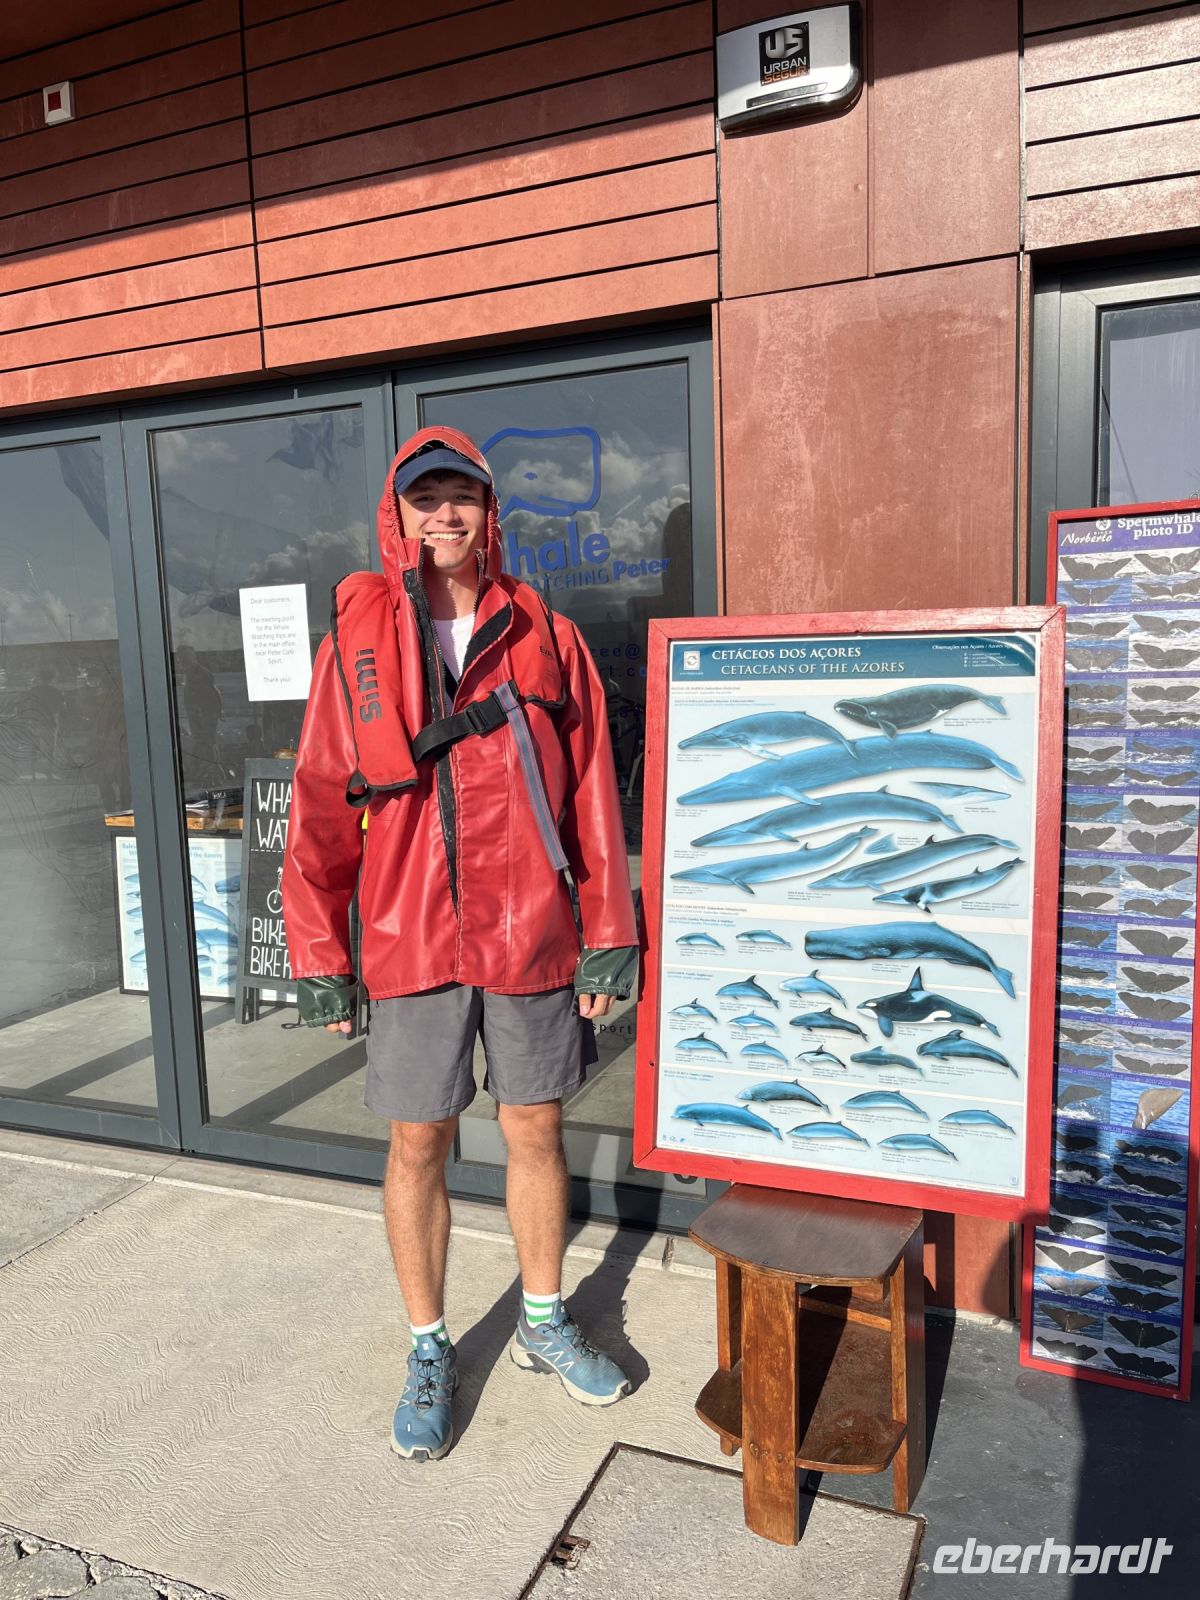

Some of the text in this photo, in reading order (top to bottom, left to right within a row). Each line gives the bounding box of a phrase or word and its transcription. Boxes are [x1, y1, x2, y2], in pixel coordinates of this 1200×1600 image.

[763, 66, 807, 84] SEGUR
[764, 57, 807, 75] URBAN
[1060, 532, 1113, 547] Norberto
[1133, 523, 1194, 540] photo ID
[503, 521, 611, 577] hale
[529, 558, 672, 592] ATCHING Peter
[712, 645, 861, 660] CETÁCEOS DOS AÇORES
[721, 661, 905, 675] CETACEANS OF THE AZORES
[252, 916, 287, 947] BIKE
